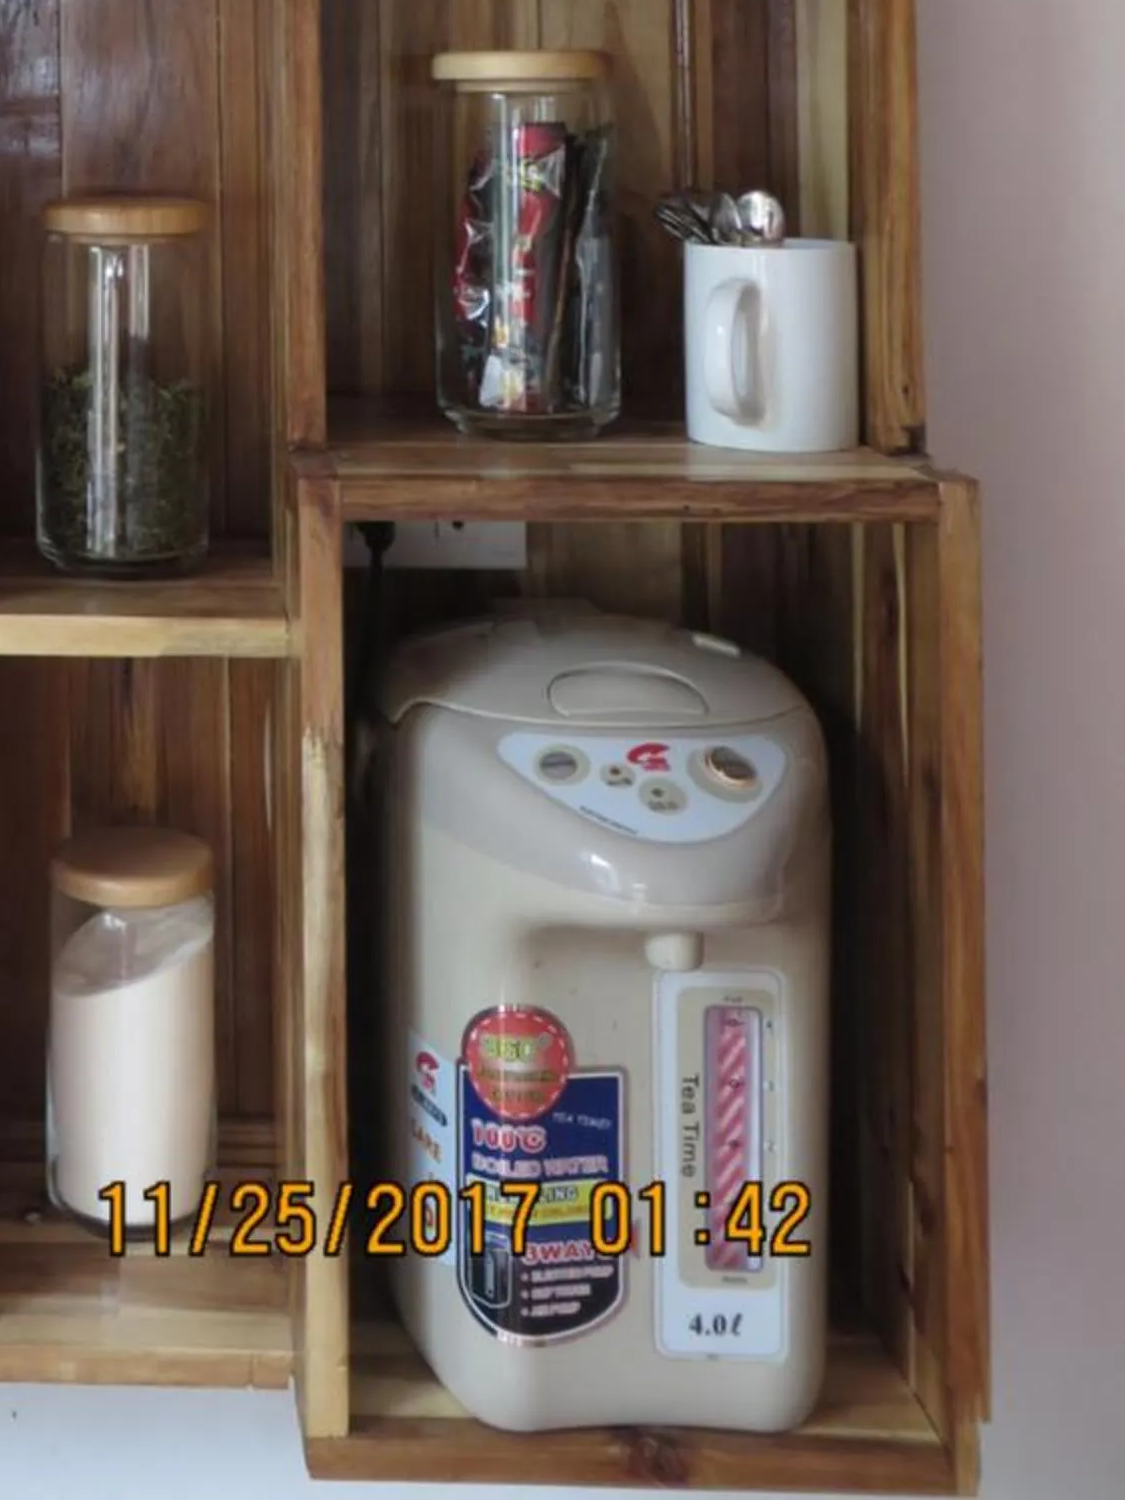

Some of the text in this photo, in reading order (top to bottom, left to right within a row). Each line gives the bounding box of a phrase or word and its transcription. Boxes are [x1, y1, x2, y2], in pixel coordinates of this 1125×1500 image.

[682, 1073, 701, 1178] Tea Time
[522, 1239, 616, 1266] 3WAY
